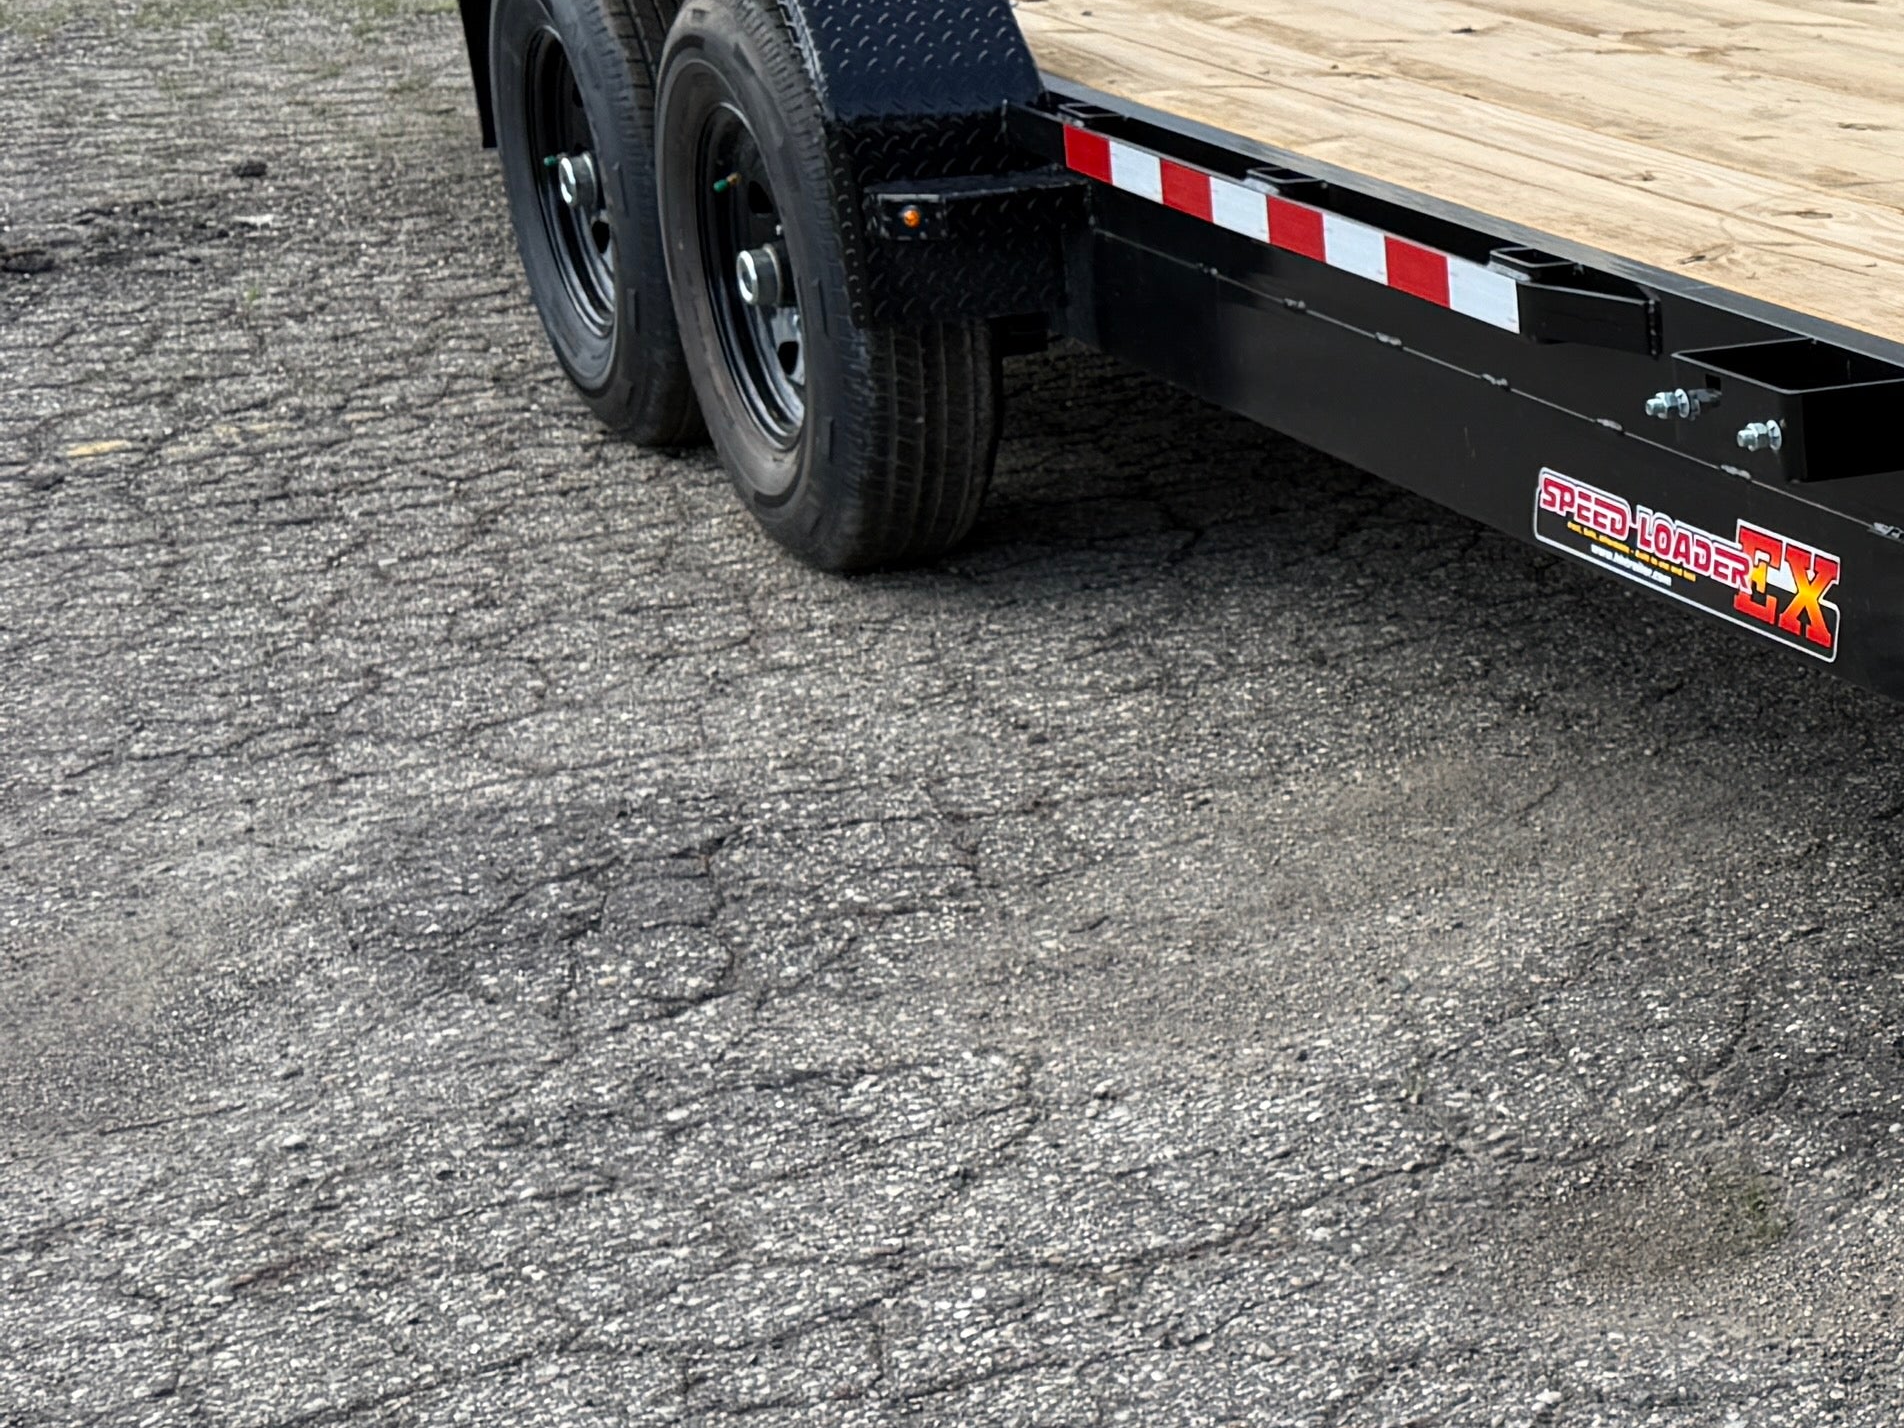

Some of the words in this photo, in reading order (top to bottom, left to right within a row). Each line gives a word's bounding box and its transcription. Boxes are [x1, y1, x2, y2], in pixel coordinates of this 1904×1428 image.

[1540, 475, 1629, 538] SPEED
[1638, 515, 1751, 591] LOADER
[1733, 525, 1839, 649] EX
